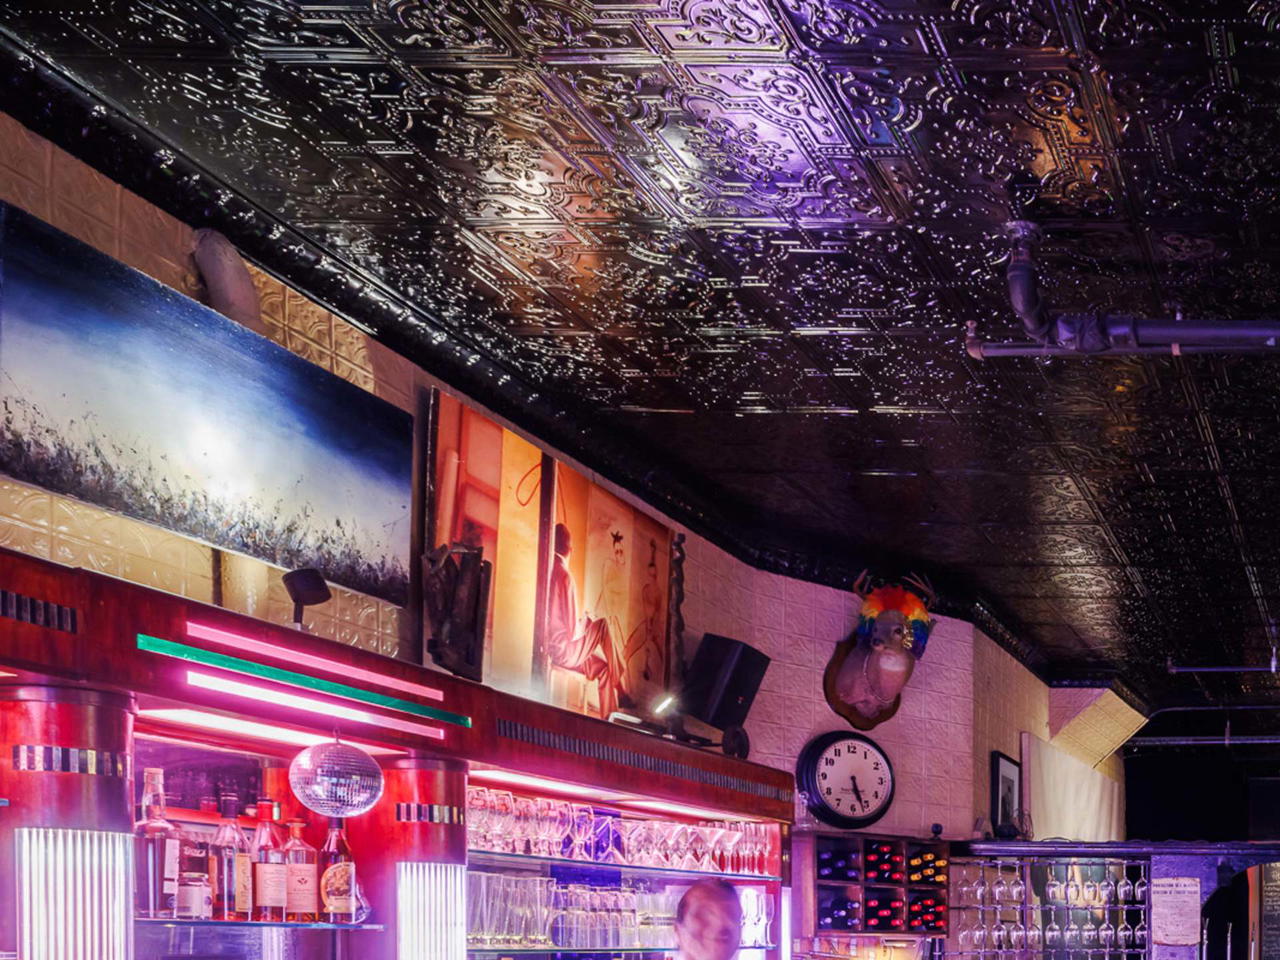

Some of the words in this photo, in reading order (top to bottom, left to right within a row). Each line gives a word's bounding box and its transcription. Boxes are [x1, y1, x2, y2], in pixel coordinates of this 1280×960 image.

[834, 748, 841, 757] 11
[847, 744, 857, 754] 12
[863, 751, 868, 760] 1
[825, 757, 835, 766] 10
[873, 761, 880, 770] 2
[821, 772, 827, 780] 9
[877, 777, 884, 785] 3
[826, 787, 832, 795] 8
[872, 790, 879, 799] 4
[835, 798, 842, 807] 7
[863, 800, 870, 809] 5
[850, 804, 857, 812] 6
